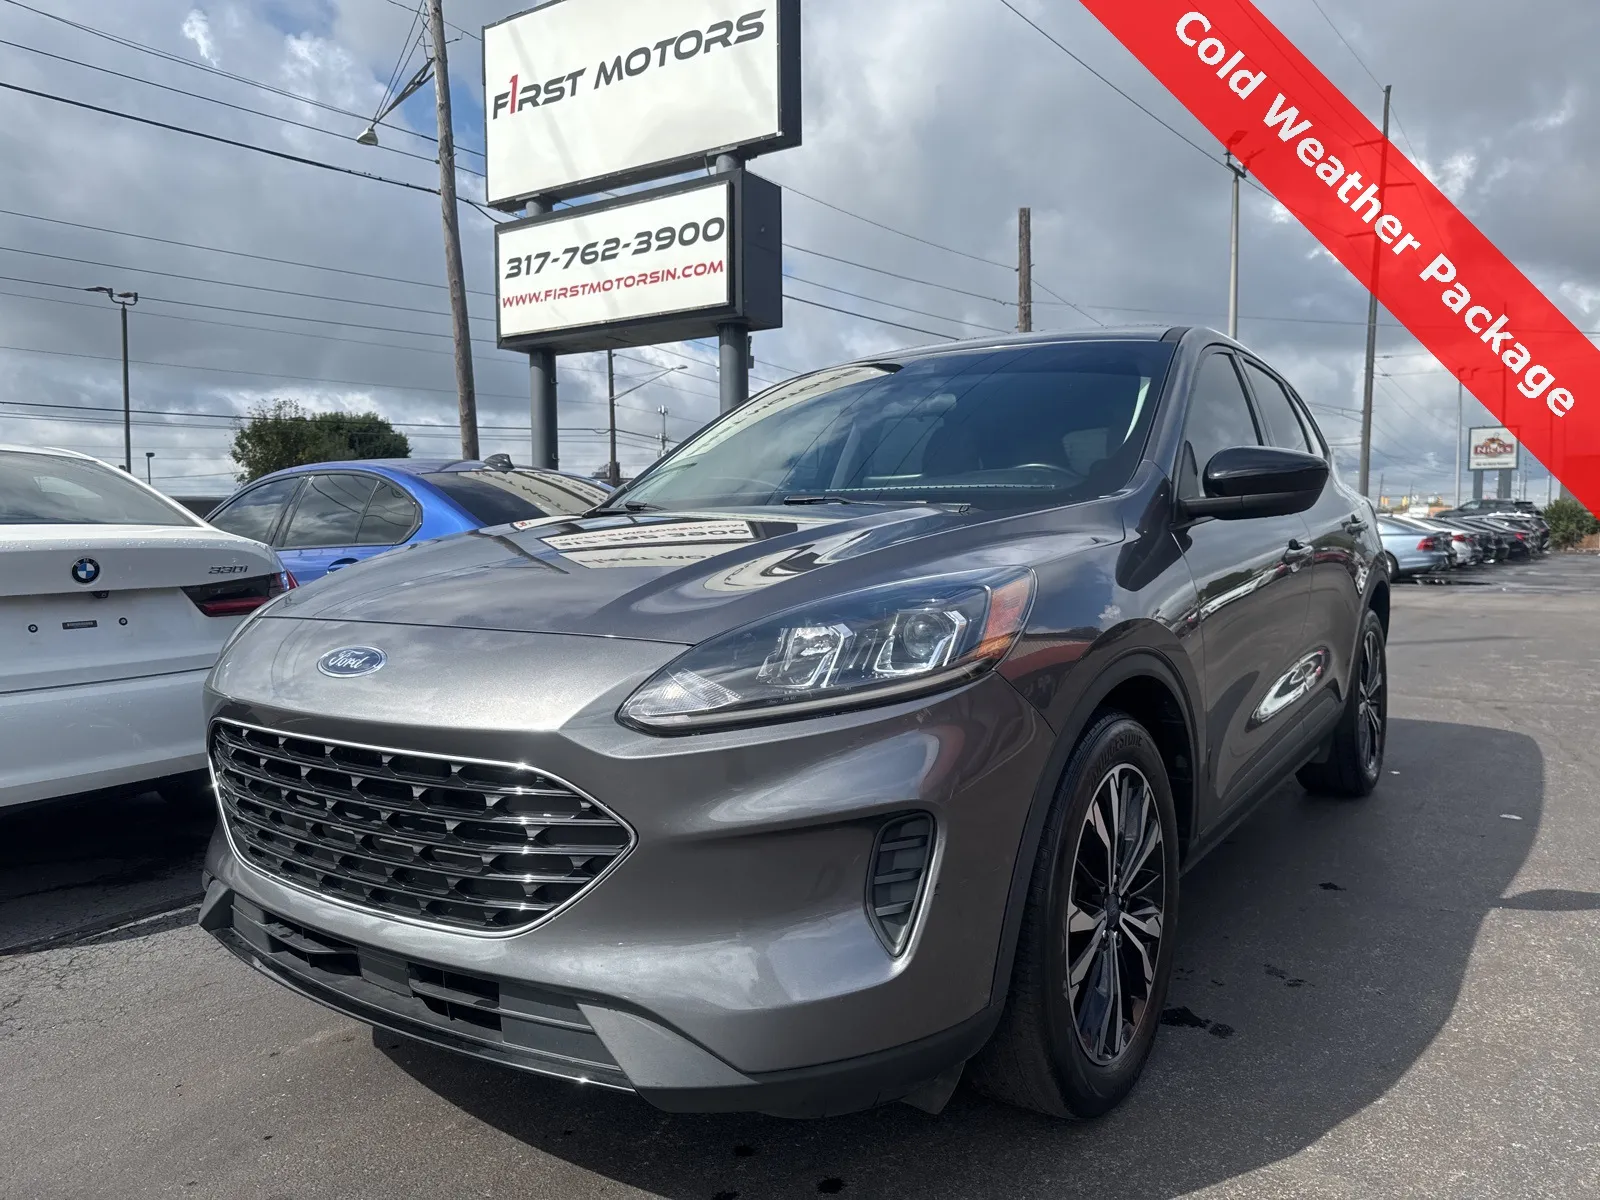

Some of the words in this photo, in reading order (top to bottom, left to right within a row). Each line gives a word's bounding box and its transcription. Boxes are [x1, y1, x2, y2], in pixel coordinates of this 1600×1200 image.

[593, 8, 767, 90] MOTORS
[504, 216, 725, 280] 317-762-3900
[502, 259, 724, 309] WWW.FIRSTMOTORSIN.COM
[208, 564, 249, 575] 330i
[328, 649, 370, 669] Ford
